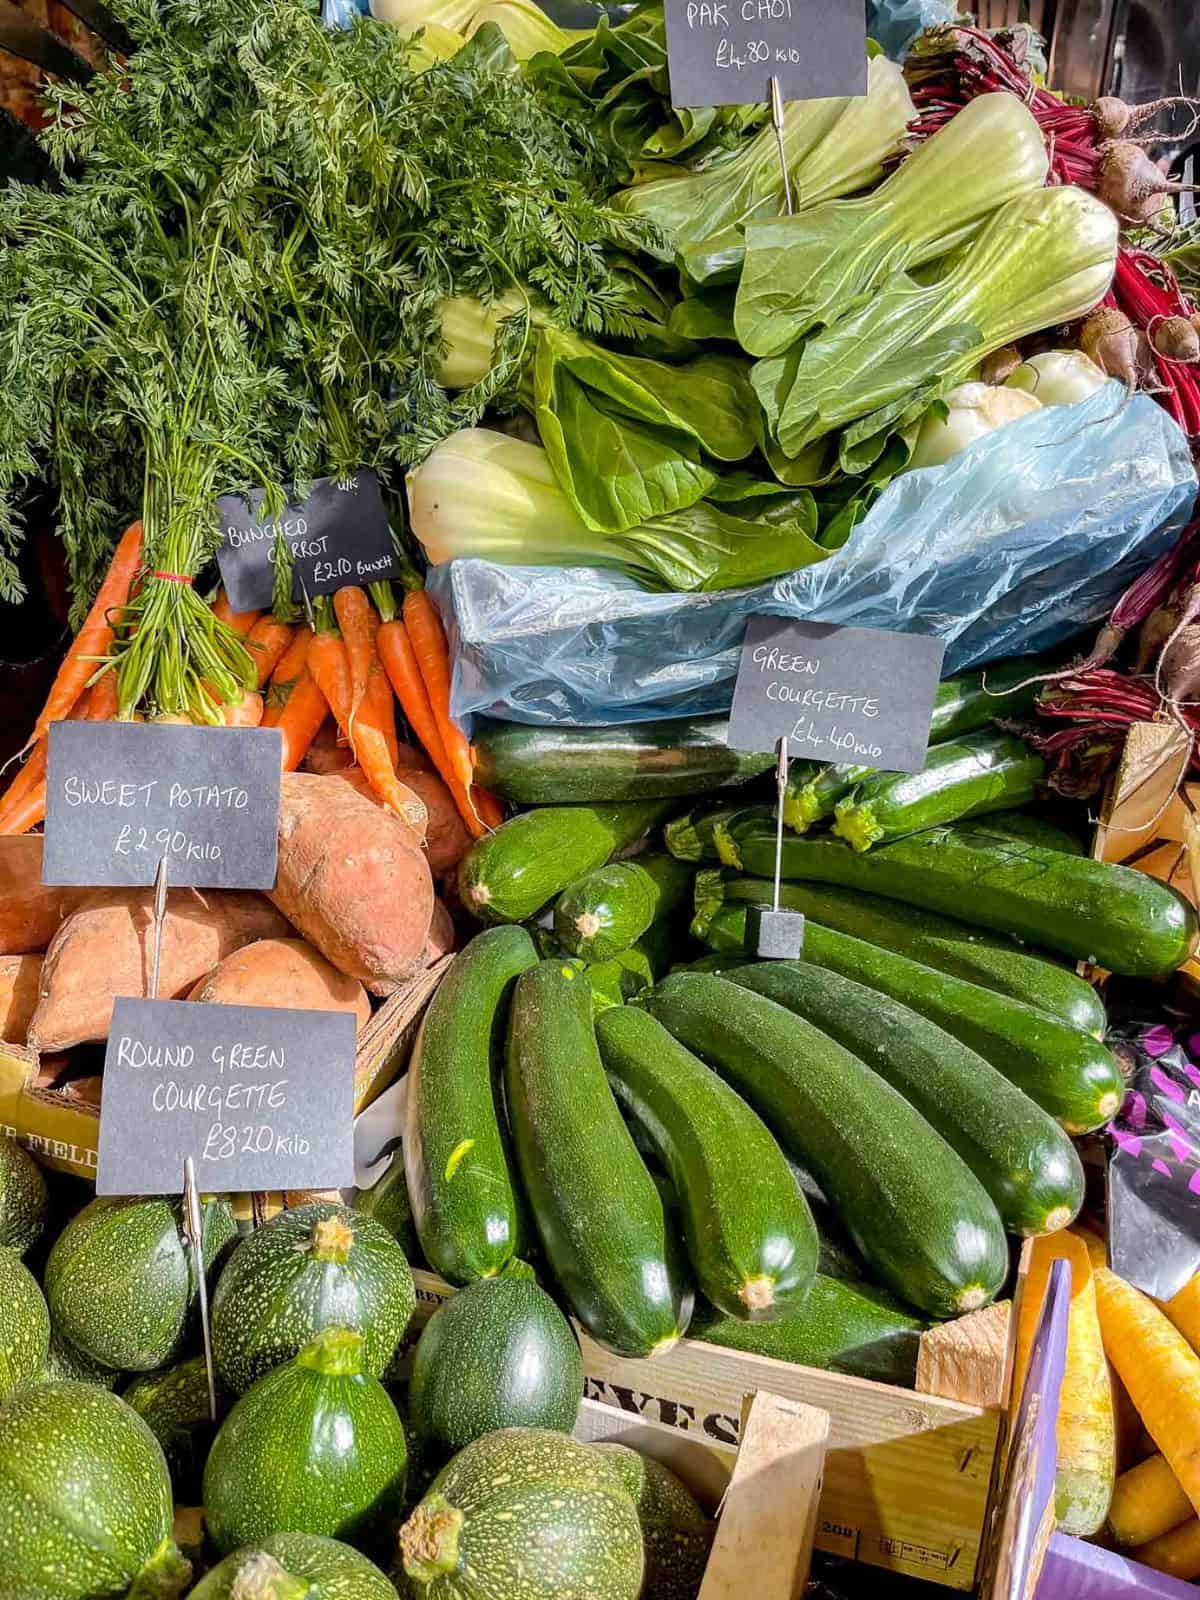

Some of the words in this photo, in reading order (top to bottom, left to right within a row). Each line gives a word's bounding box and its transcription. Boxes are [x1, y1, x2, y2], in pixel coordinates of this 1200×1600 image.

[687, 1, 729, 29] PAK
[741, 0, 792, 21] CHOI
[267, 535, 329, 563] CRROT
[752, 646, 820, 675] GREEN
[766, 681, 881, 718] COURGETTE
[64, 776, 159, 808] SWEET
[169, 783, 249, 809] POTATO
[118, 1037, 194, 1068] ROUND
[211, 1043, 286, 1074] GREEN
[152, 1080, 289, 1121] COURGETTE
